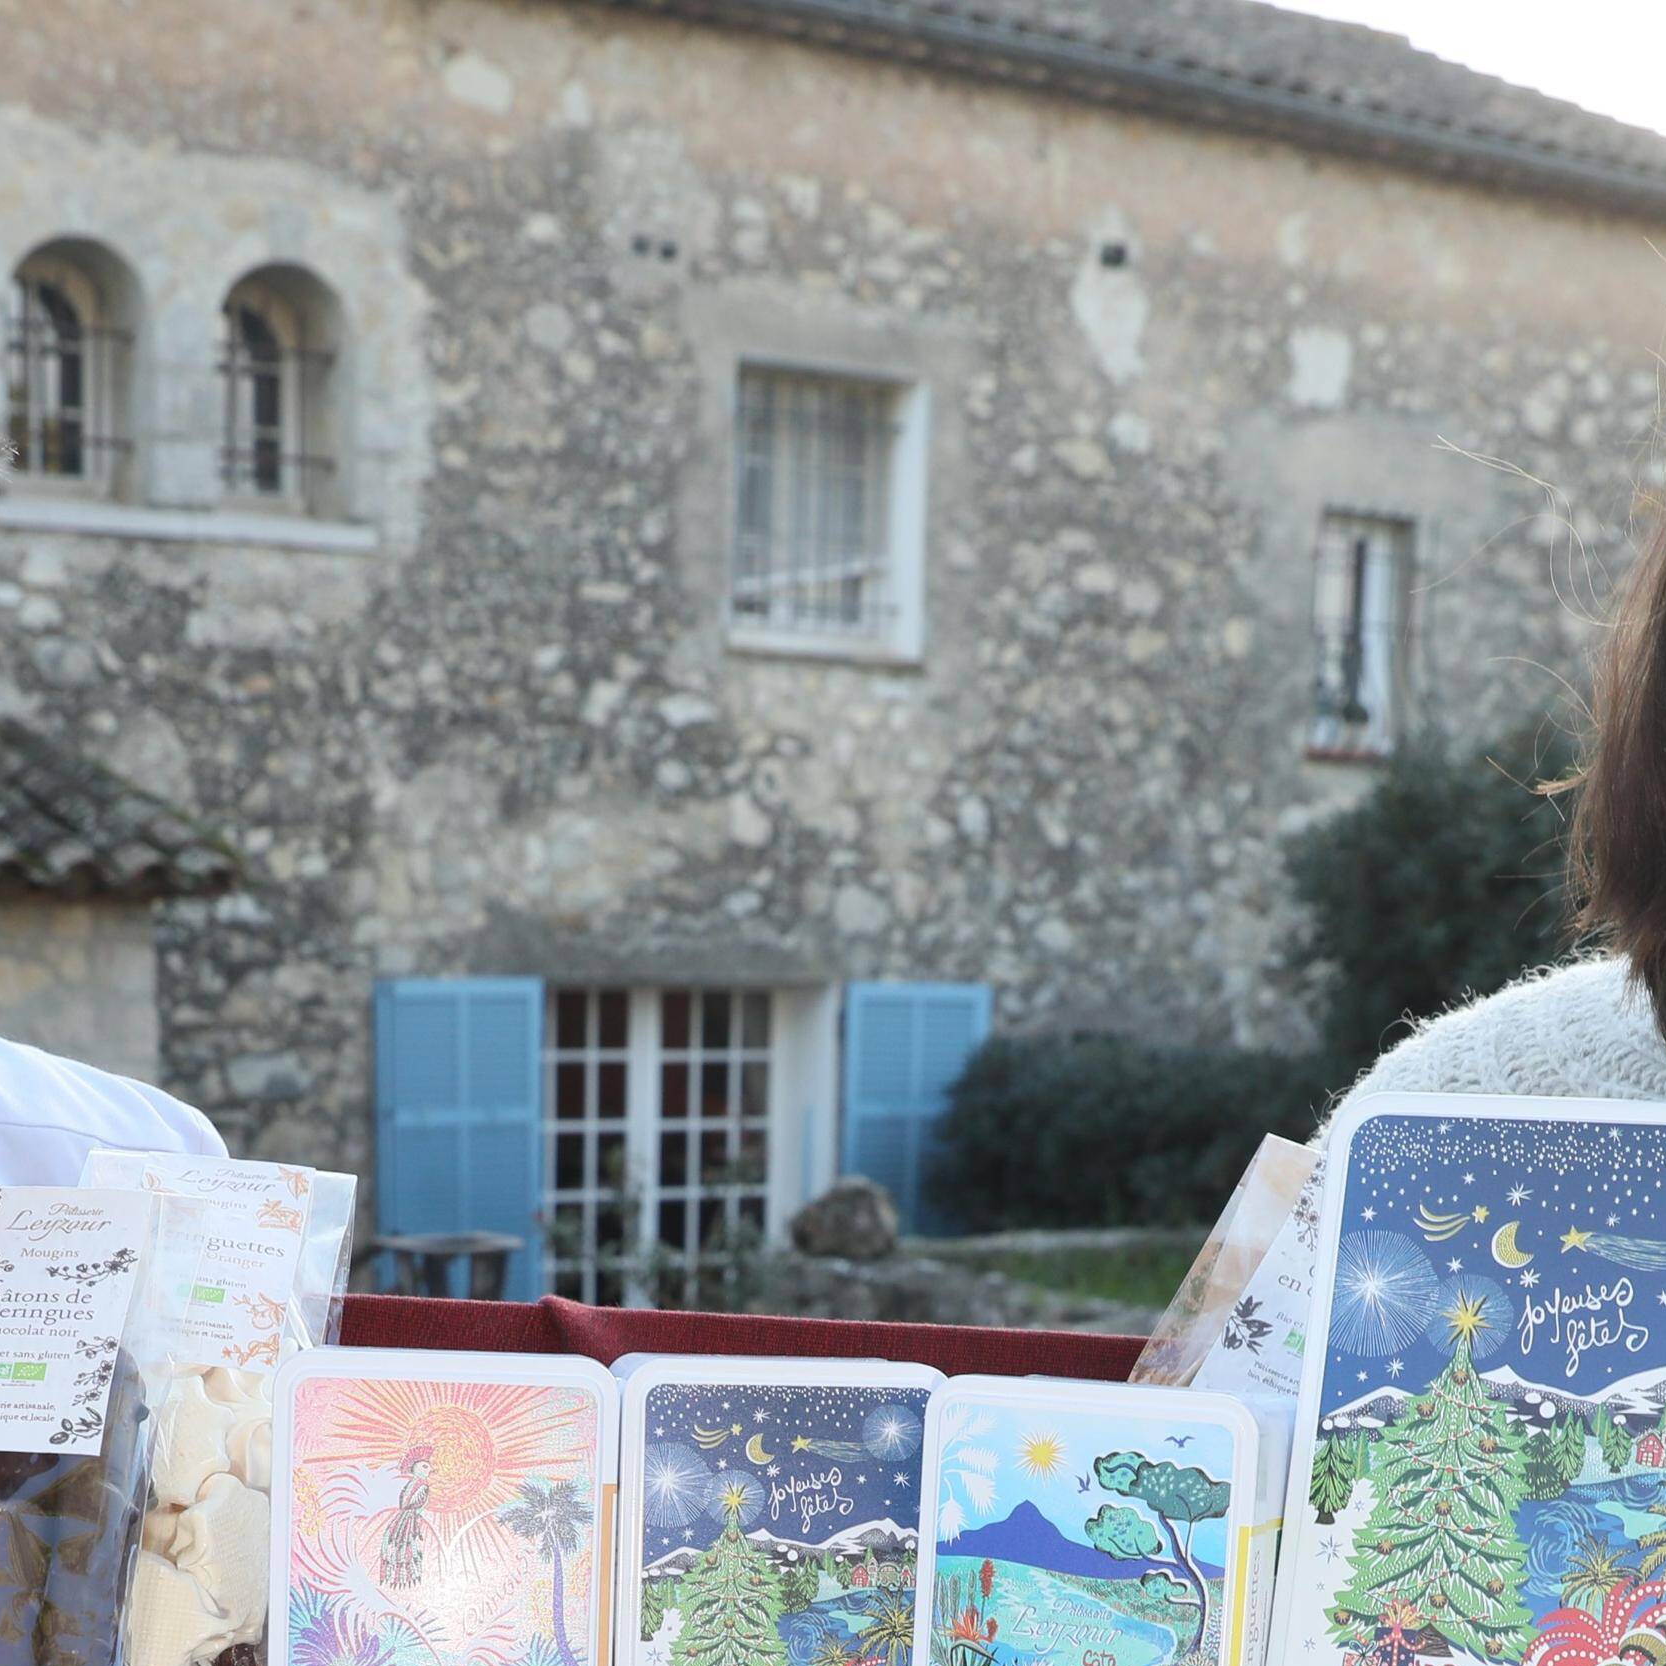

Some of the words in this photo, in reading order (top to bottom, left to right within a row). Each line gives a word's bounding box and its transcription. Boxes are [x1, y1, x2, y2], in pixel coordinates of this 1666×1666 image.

[176, 1169, 276, 1193] Leyzour
[48, 1203, 104, 1216] Pâtisserie
[6, 1209, 112, 1242] Leyzour
[20, 1248, 79, 1261] Mougins
[1277, 1273, 1302, 1292] en
[65, 1288, 93, 1304] de
[1276, 1312, 1293, 1326] Bio
[1294, 1319, 1304, 1328] et
[49, 1327, 79, 1338] noir
[1565, 1307, 1649, 1378] fêtes
[13, 1351, 34, 1360] sans
[37, 1350, 71, 1360] gluten
[801, 1488, 854, 1534] fêtes
[1012, 1606, 1123, 1656] Leyzour
